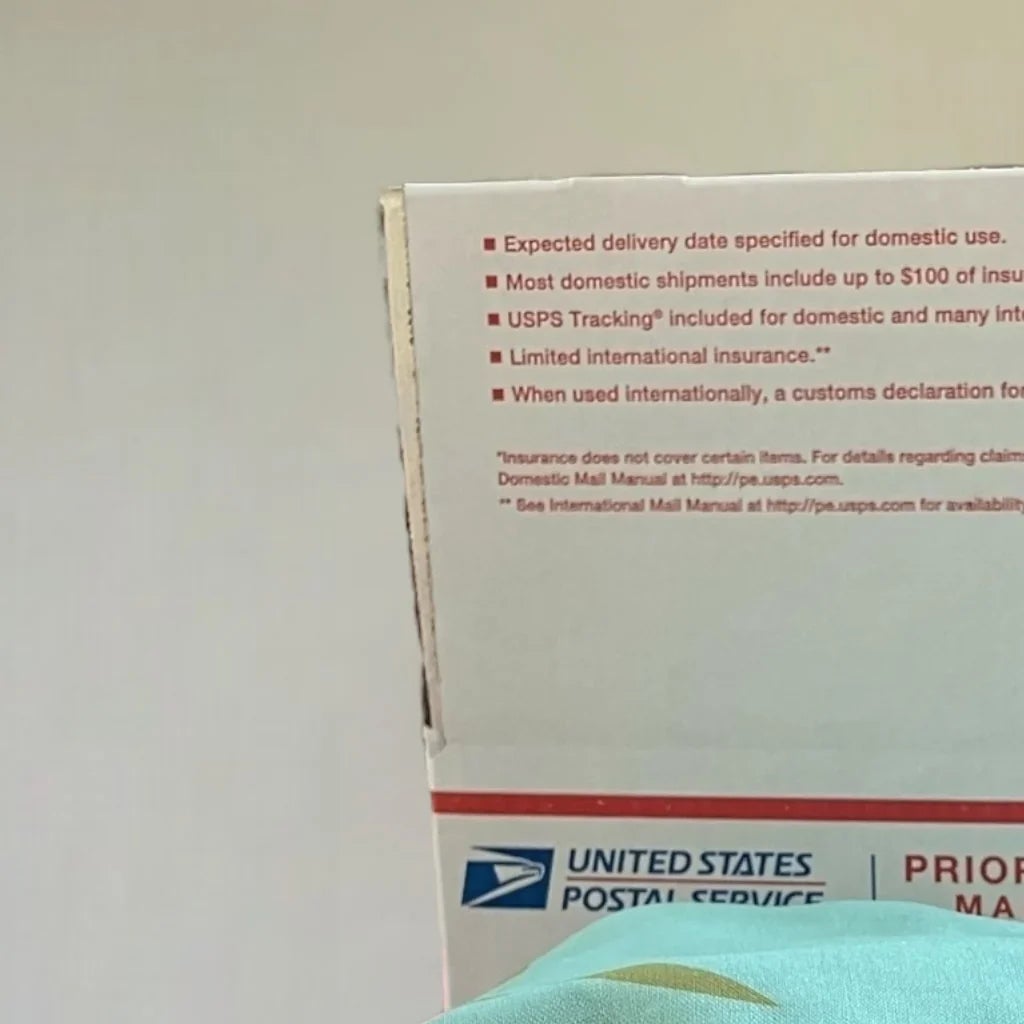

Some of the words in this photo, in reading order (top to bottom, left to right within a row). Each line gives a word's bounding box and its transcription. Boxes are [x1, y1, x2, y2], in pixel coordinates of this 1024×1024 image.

[504, 234, 595, 256] Expected
[602, 233, 678, 254] delivery
[684, 232, 728, 249] date
[734, 230, 824, 252] specified
[831, 230, 859, 247] for
[865, 228, 958, 246] domestic
[965, 231, 1006, 245] use.
[506, 273, 554, 291] Most
[560, 272, 650, 290] domestic
[656, 270, 758, 292] shipments
[764, 268, 837, 287] include
[843, 272, 868, 290] up
[874, 269, 895, 285] to
[901, 266, 949, 286] $100
[956, 266, 976, 284] of
[508, 310, 563, 328] USPS
[669, 308, 753, 327] included
[760, 309, 788, 326] for
[793, 307, 884, 325] domestic
[891, 306, 928, 324] and
[935, 309, 989, 327] many
[510, 348, 581, 366] Limited
[587, 347, 707, 365] international
[511, 385, 566, 403] When
[573, 384, 619, 402] used
[625, 384, 768, 406] internationally,
[774, 388, 786, 401] a
[792, 384, 877, 401] customs
[882, 382, 994, 400] declaration
[498, 472, 570, 486] Domestic
[574, 472, 606, 486] Mail
[611, 472, 667, 486] Manual
[672, 473, 687, 486] at
[568, 848, 692, 875] UNITED
[697, 851, 812, 877] STATES
